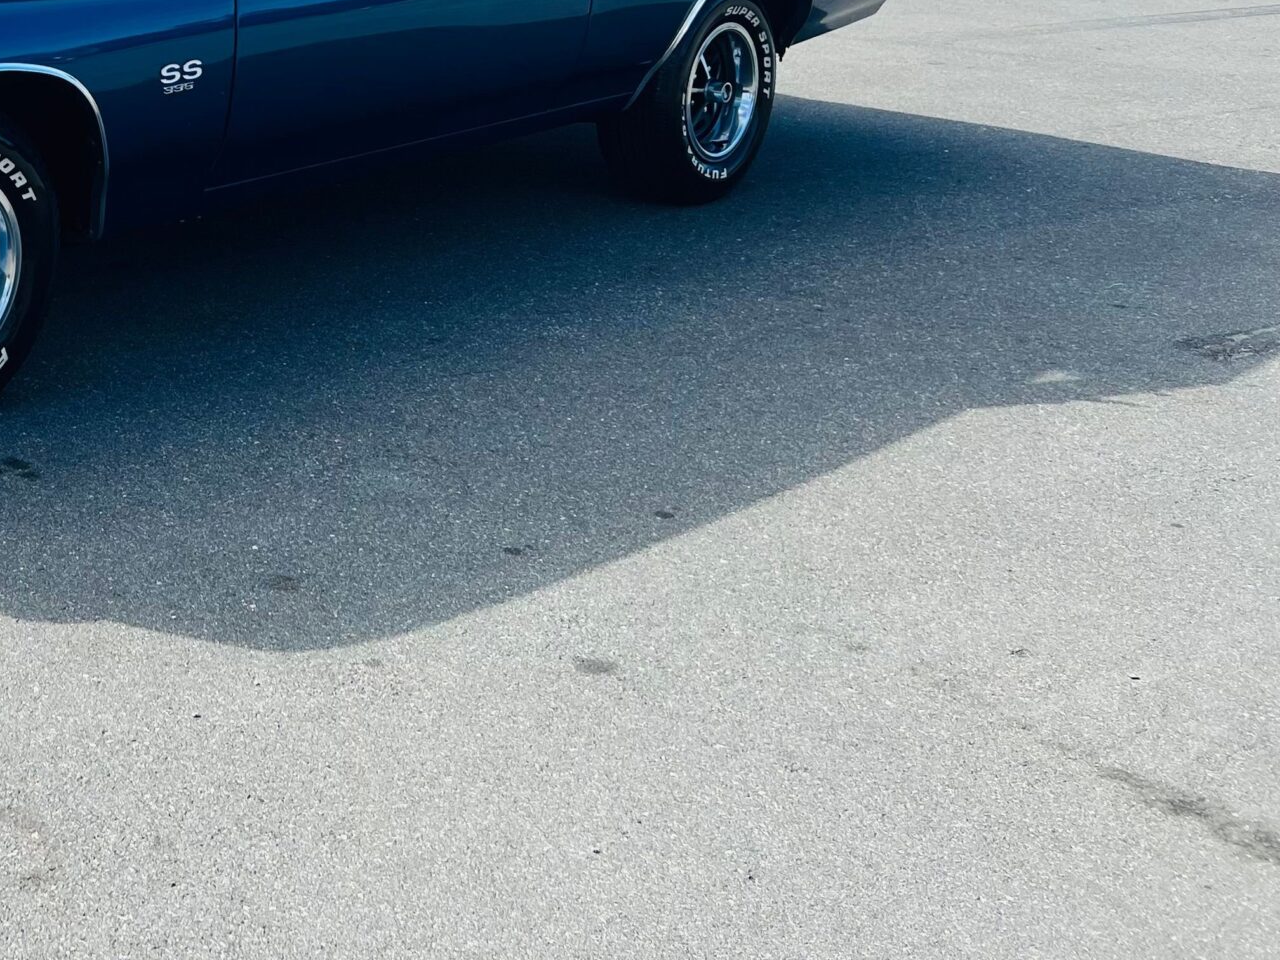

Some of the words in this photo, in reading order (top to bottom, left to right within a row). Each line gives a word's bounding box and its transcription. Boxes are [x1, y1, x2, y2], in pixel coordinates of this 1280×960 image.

[160, 59, 203, 84] SS
[724, 5, 761, 28] SUPER
[758, 31, 771, 100] SPORT
